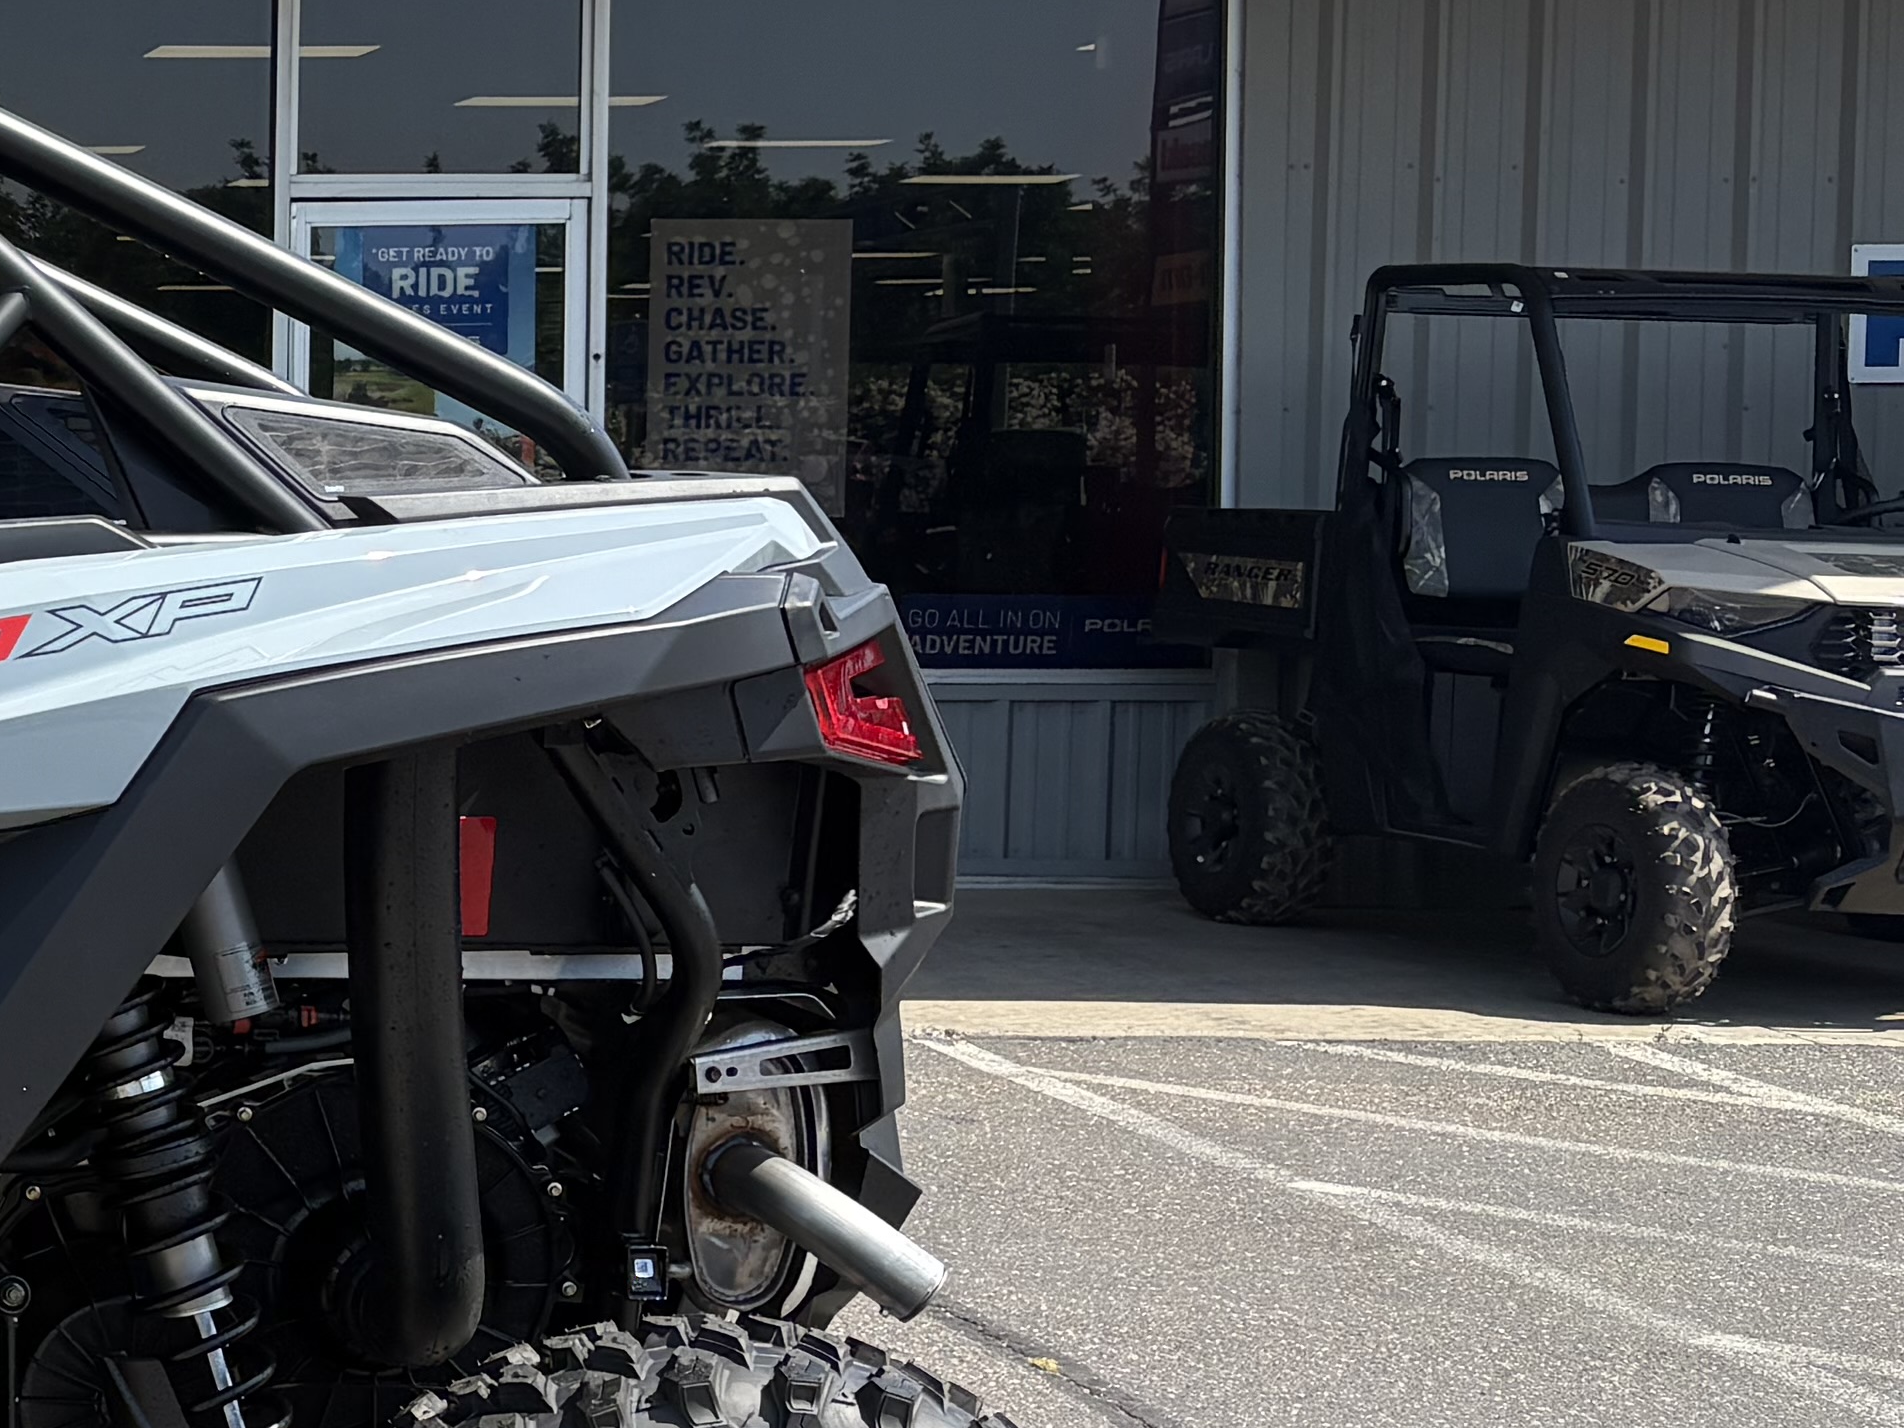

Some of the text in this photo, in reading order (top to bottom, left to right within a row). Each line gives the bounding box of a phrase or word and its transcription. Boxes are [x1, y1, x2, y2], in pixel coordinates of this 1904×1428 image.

[414, 246, 469, 261] READY
[472, 246, 494, 261] TO
[666, 241, 745, 266] RIDE.
[391, 266, 480, 299] RIDE
[666, 274, 733, 299] REV.
[440, 303, 494, 315] EVENT
[664, 307, 777, 332] CHASE.
[664, 340, 795, 365] GATHER.
[663, 373, 815, 397] EXPLORE.
[662, 437, 789, 463] REPEAT.
[1449, 470, 1529, 482] POLARIS
[1693, 474, 1773, 486] POLARIS
[1204, 560, 1292, 583] RANGER
[1581, 560, 1638, 587] 570
[908, 608, 1061, 629] GO ALL IN ON
[1084, 618, 1152, 632] POLA
[909, 634, 1058, 655] ADVENTURE
